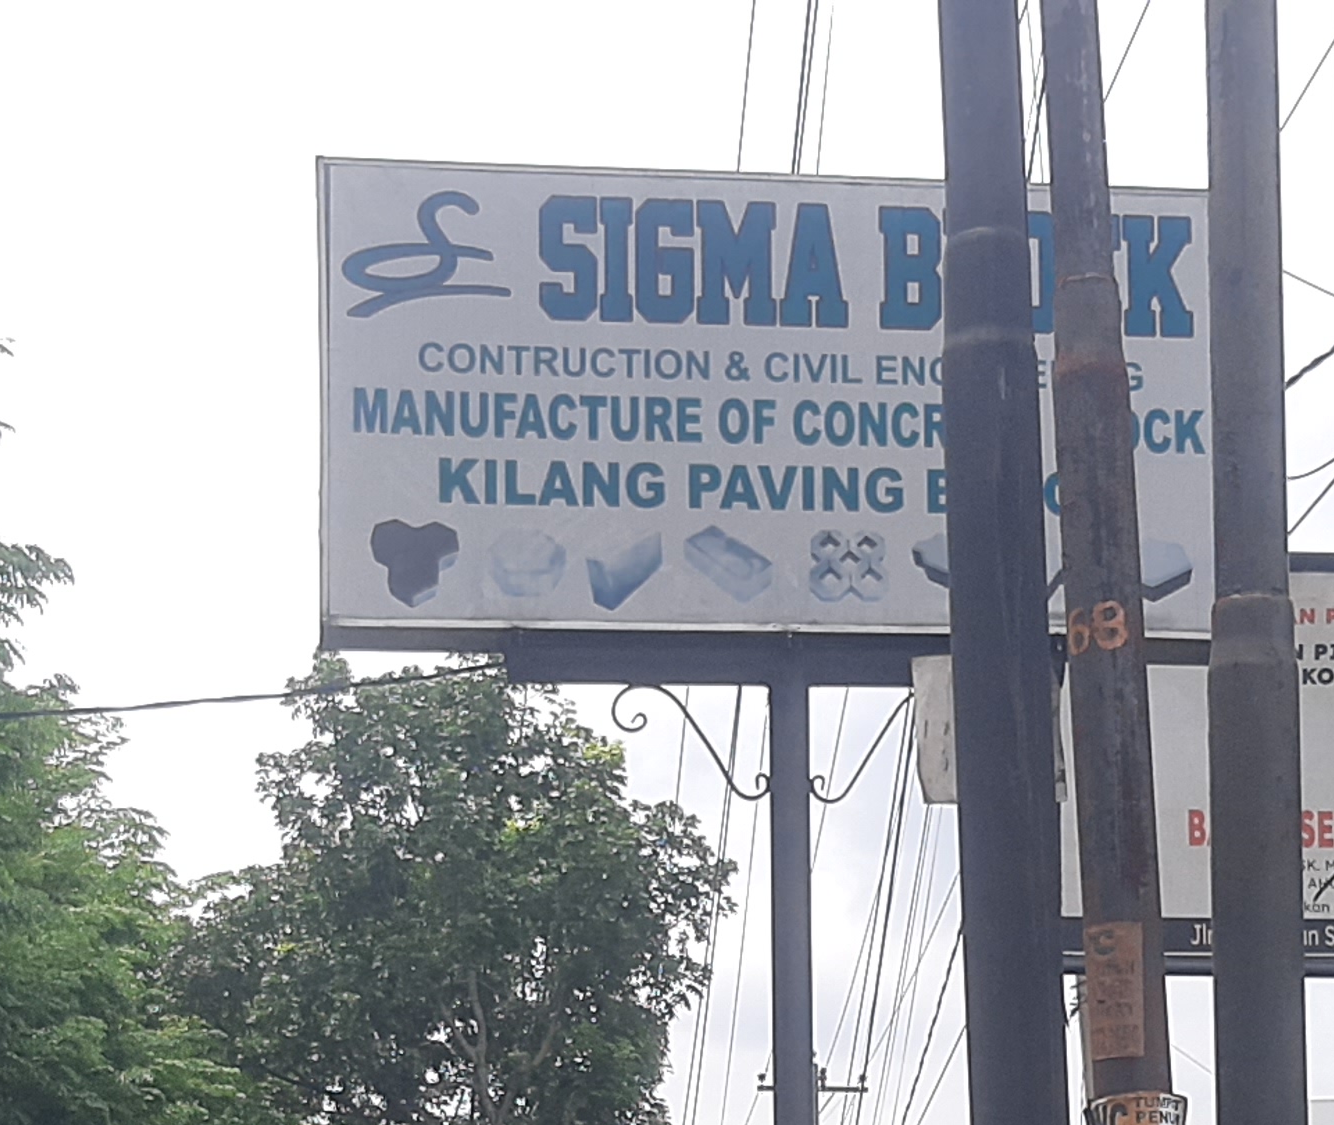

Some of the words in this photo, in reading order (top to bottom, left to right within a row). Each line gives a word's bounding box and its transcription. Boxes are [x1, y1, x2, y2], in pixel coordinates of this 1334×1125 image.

[539, 195, 849, 328] SIGMA
[418, 342, 711, 380] CONTRUCTION
[725, 351, 750, 381] &
[763, 352, 862, 384] CIVIL
[353, 387, 702, 443] MANUFACTURE
[718, 398, 777, 444] OF
[792, 399, 946, 449] CONCR
[438, 457, 666, 509] KILANG
[688, 463, 904, 513] PAVING
